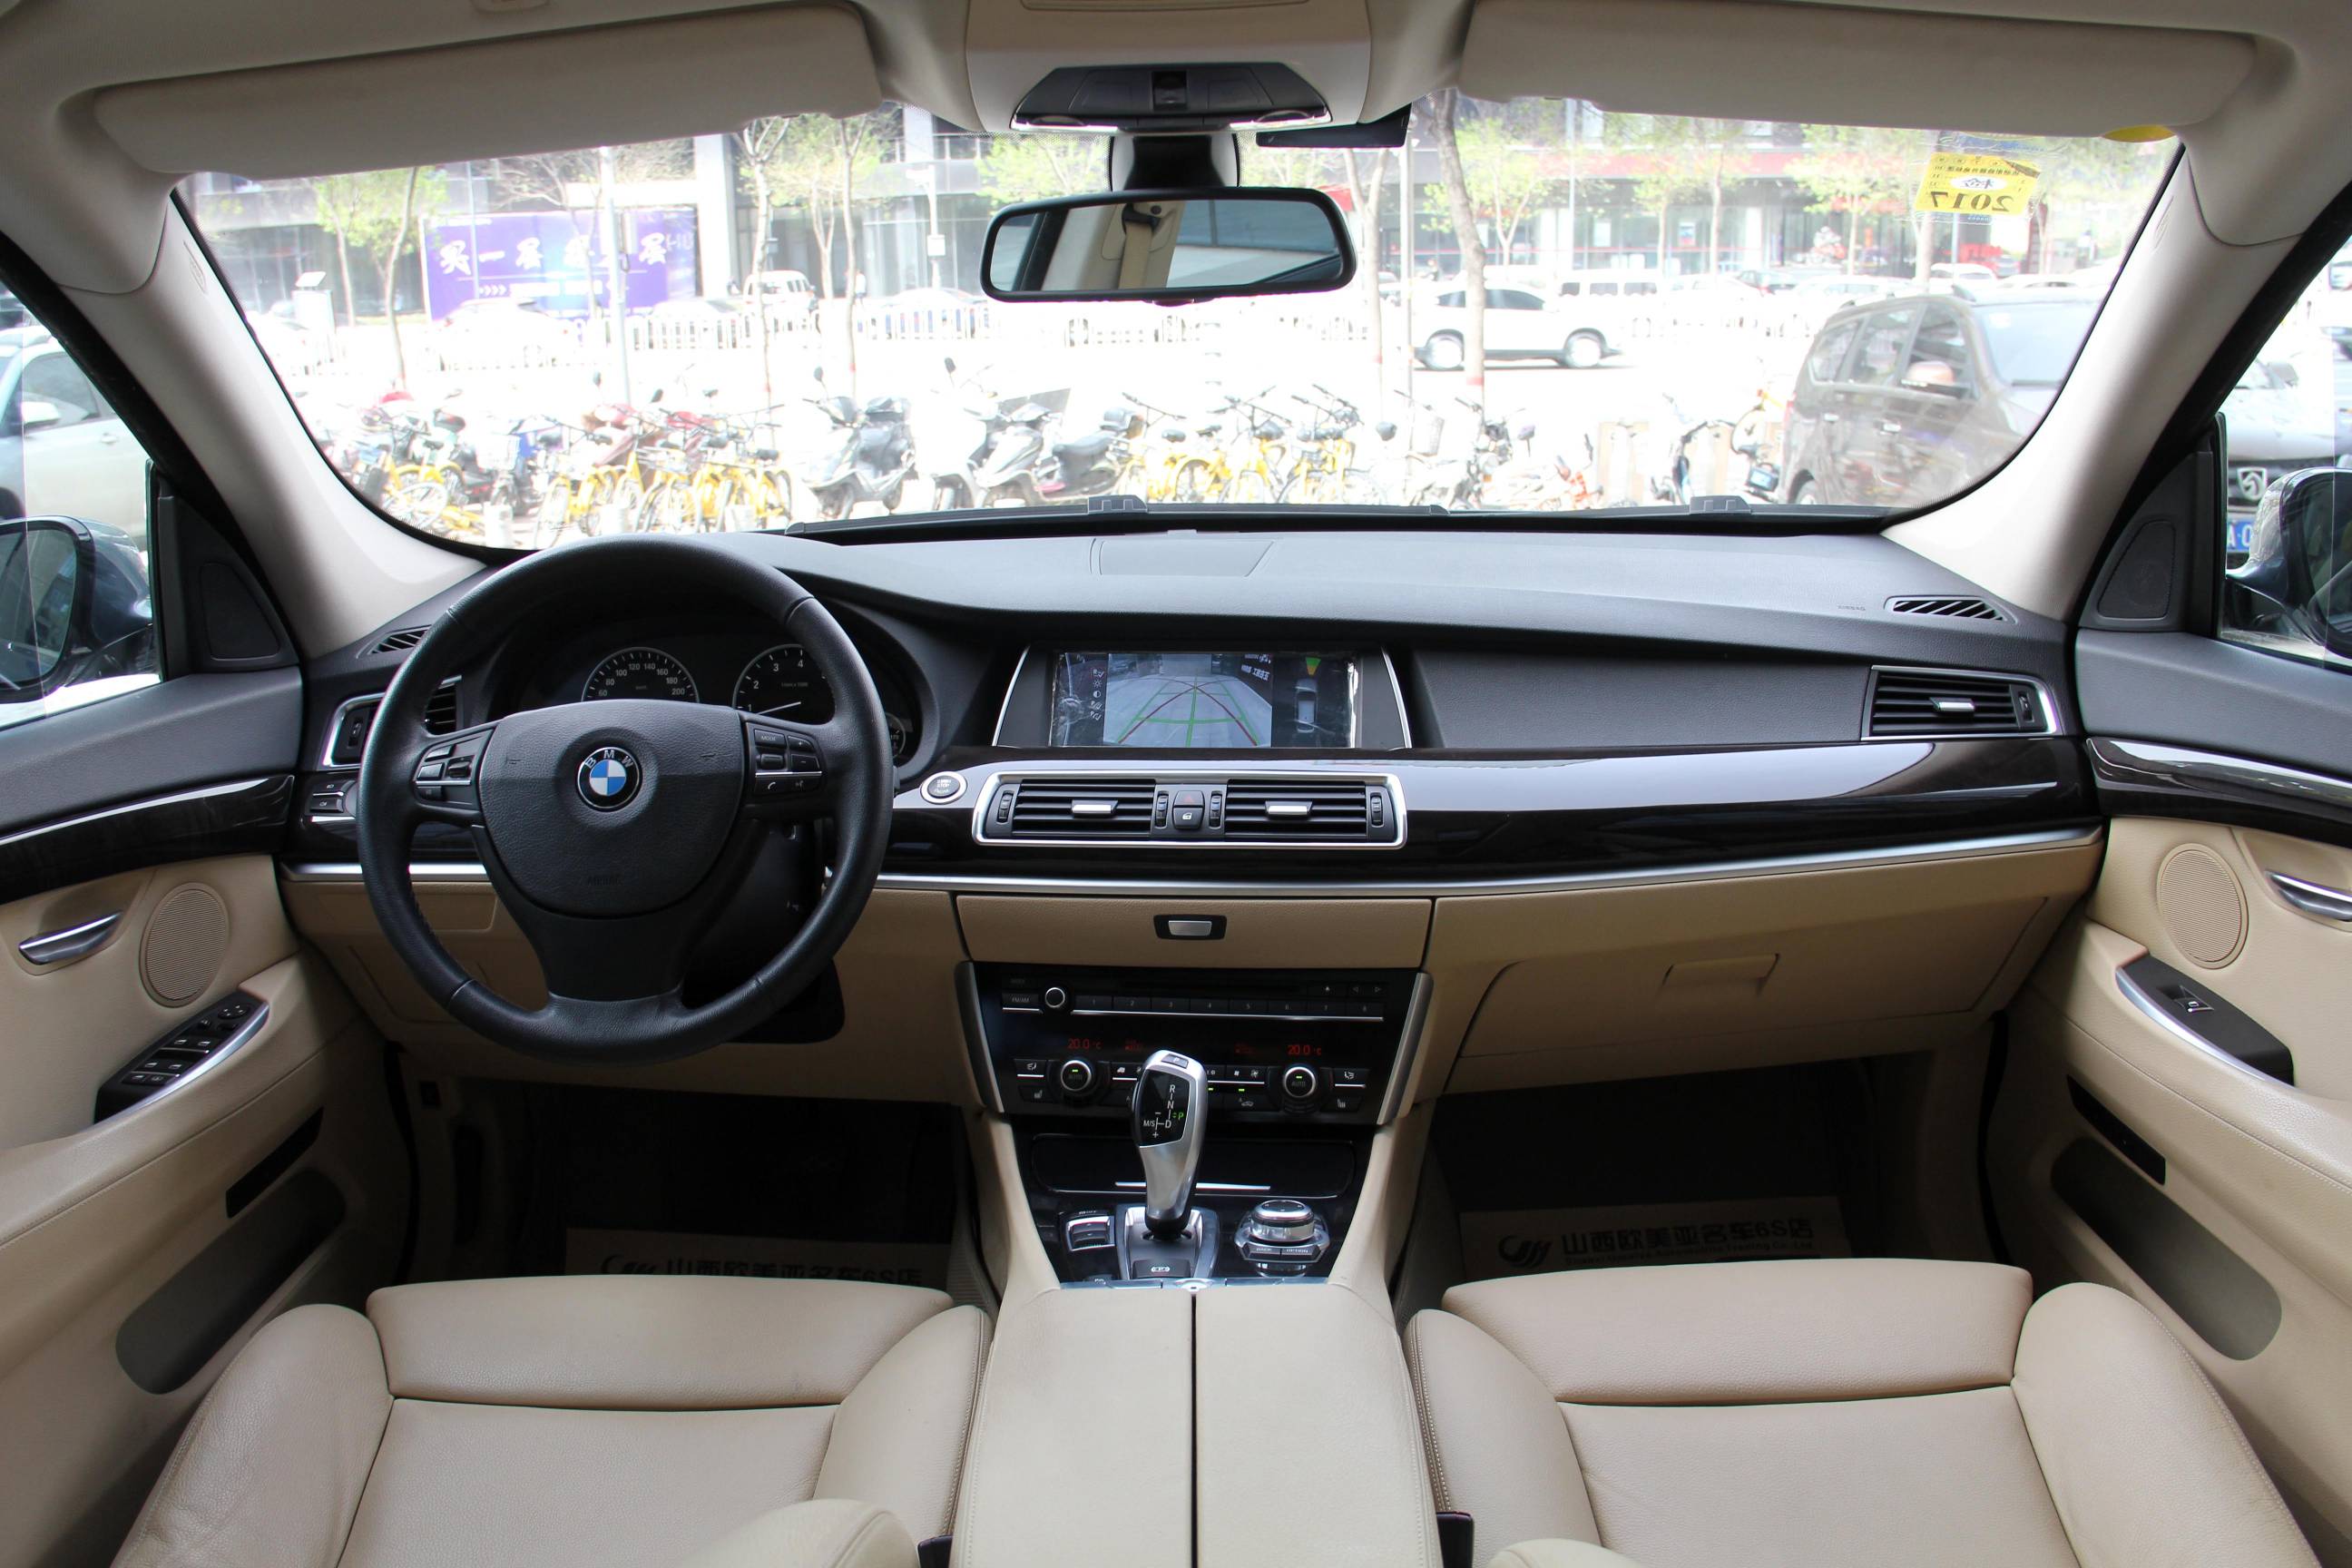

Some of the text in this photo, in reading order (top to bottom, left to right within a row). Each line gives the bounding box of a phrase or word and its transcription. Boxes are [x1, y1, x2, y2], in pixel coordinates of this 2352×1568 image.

[628, 662, 641, 671] 120
[773, 663, 779, 672] 3
[798, 660, 804, 669] 4
[616, 669, 628, 677] 100
[656, 668, 669, 676] 160
[666, 677, 679, 685] 180
[753, 681, 760, 690] 2
[671, 688, 686, 696] 200
[584, 750, 634, 769] BMW
[1169, 1084, 1176, 1093] R
[1167, 1100, 1174, 1109] N
[1178, 1112, 1184, 1121] P
[1143, 1119, 1172, 1129] M/S D
